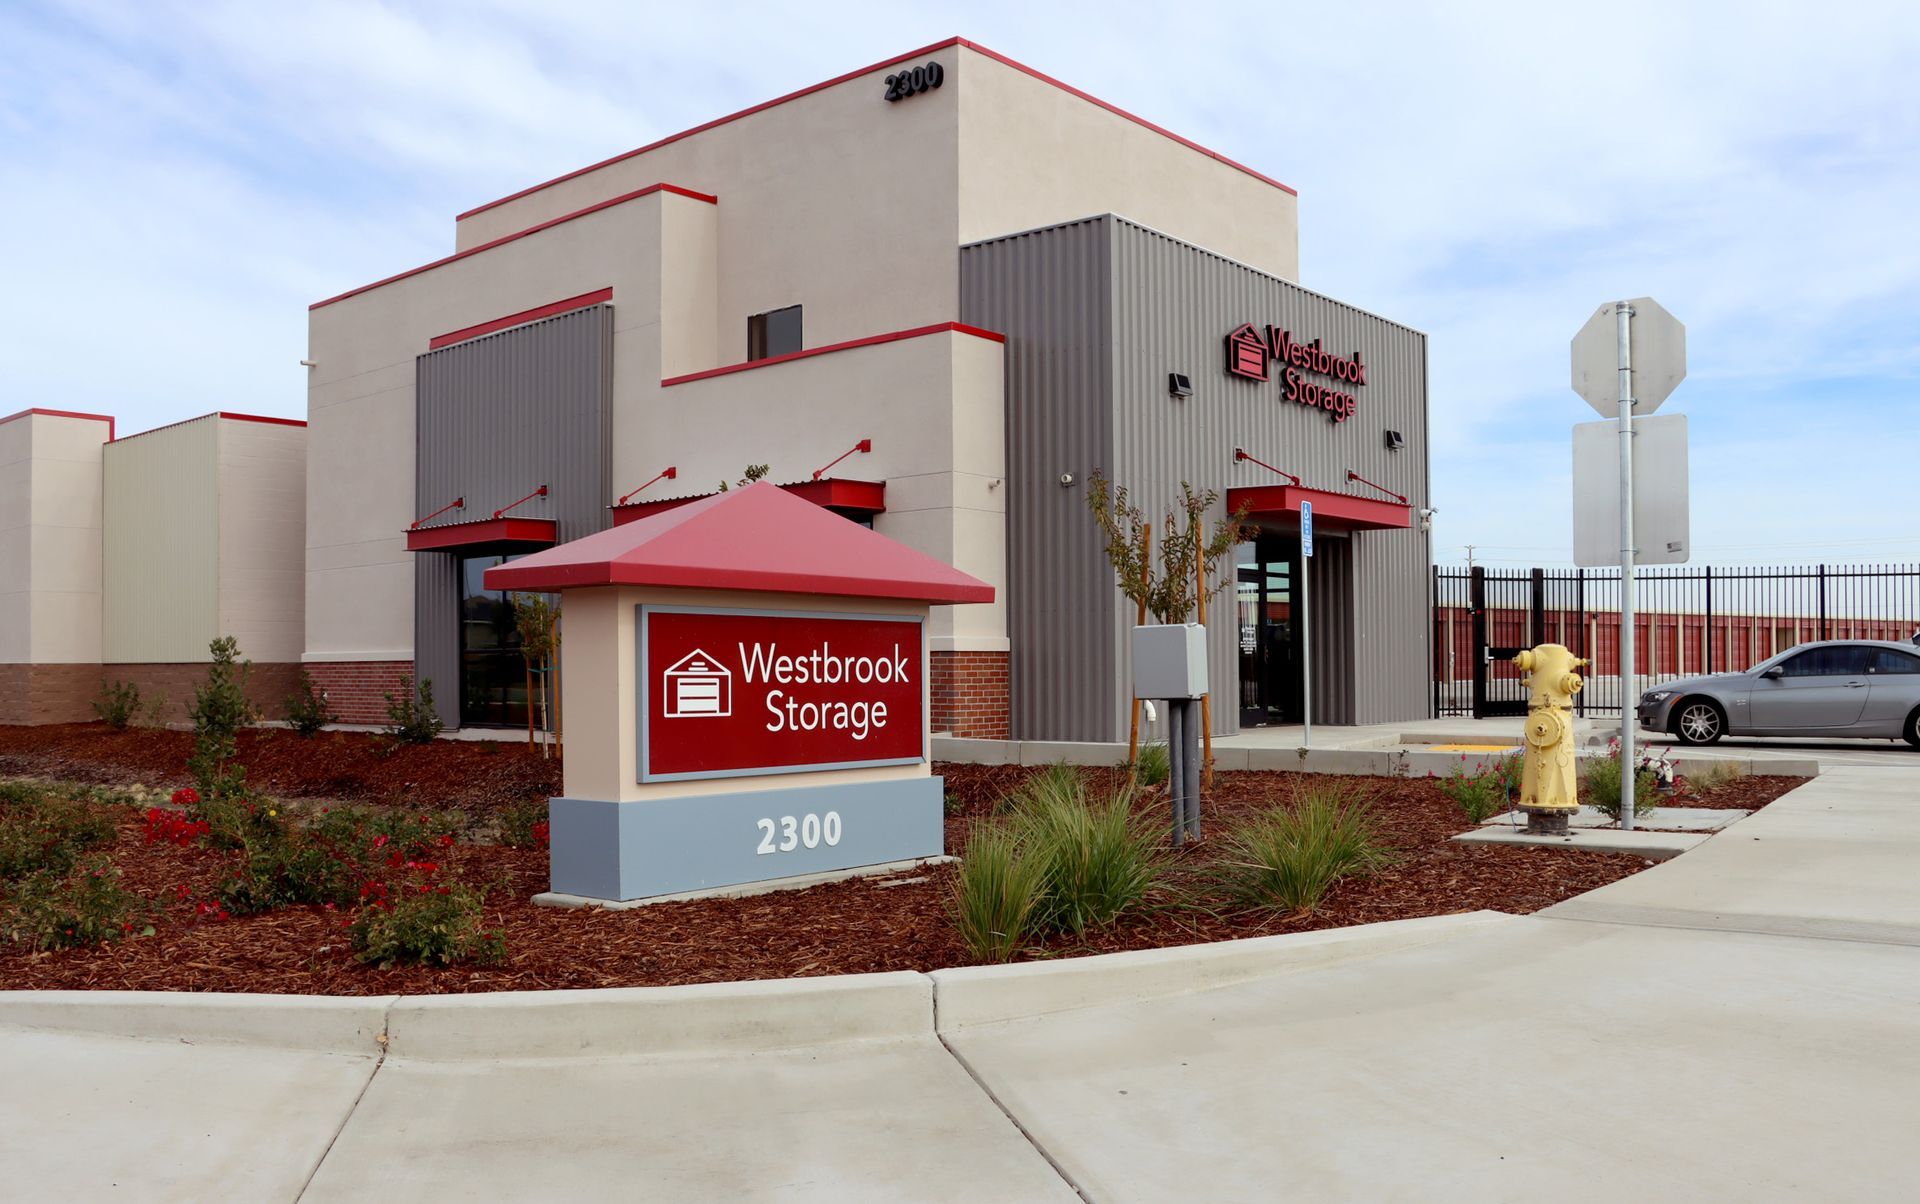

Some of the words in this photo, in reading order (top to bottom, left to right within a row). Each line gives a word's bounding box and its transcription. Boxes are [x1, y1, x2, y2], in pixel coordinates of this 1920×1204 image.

[884, 61, 944, 102] 2300
[1266, 324, 1367, 385] Westbrook
[1282, 367, 1357, 423] Storage
[738, 641, 909, 684] Westbrook
[766, 690, 888, 740] Storage
[756, 811, 842, 855] 2300
